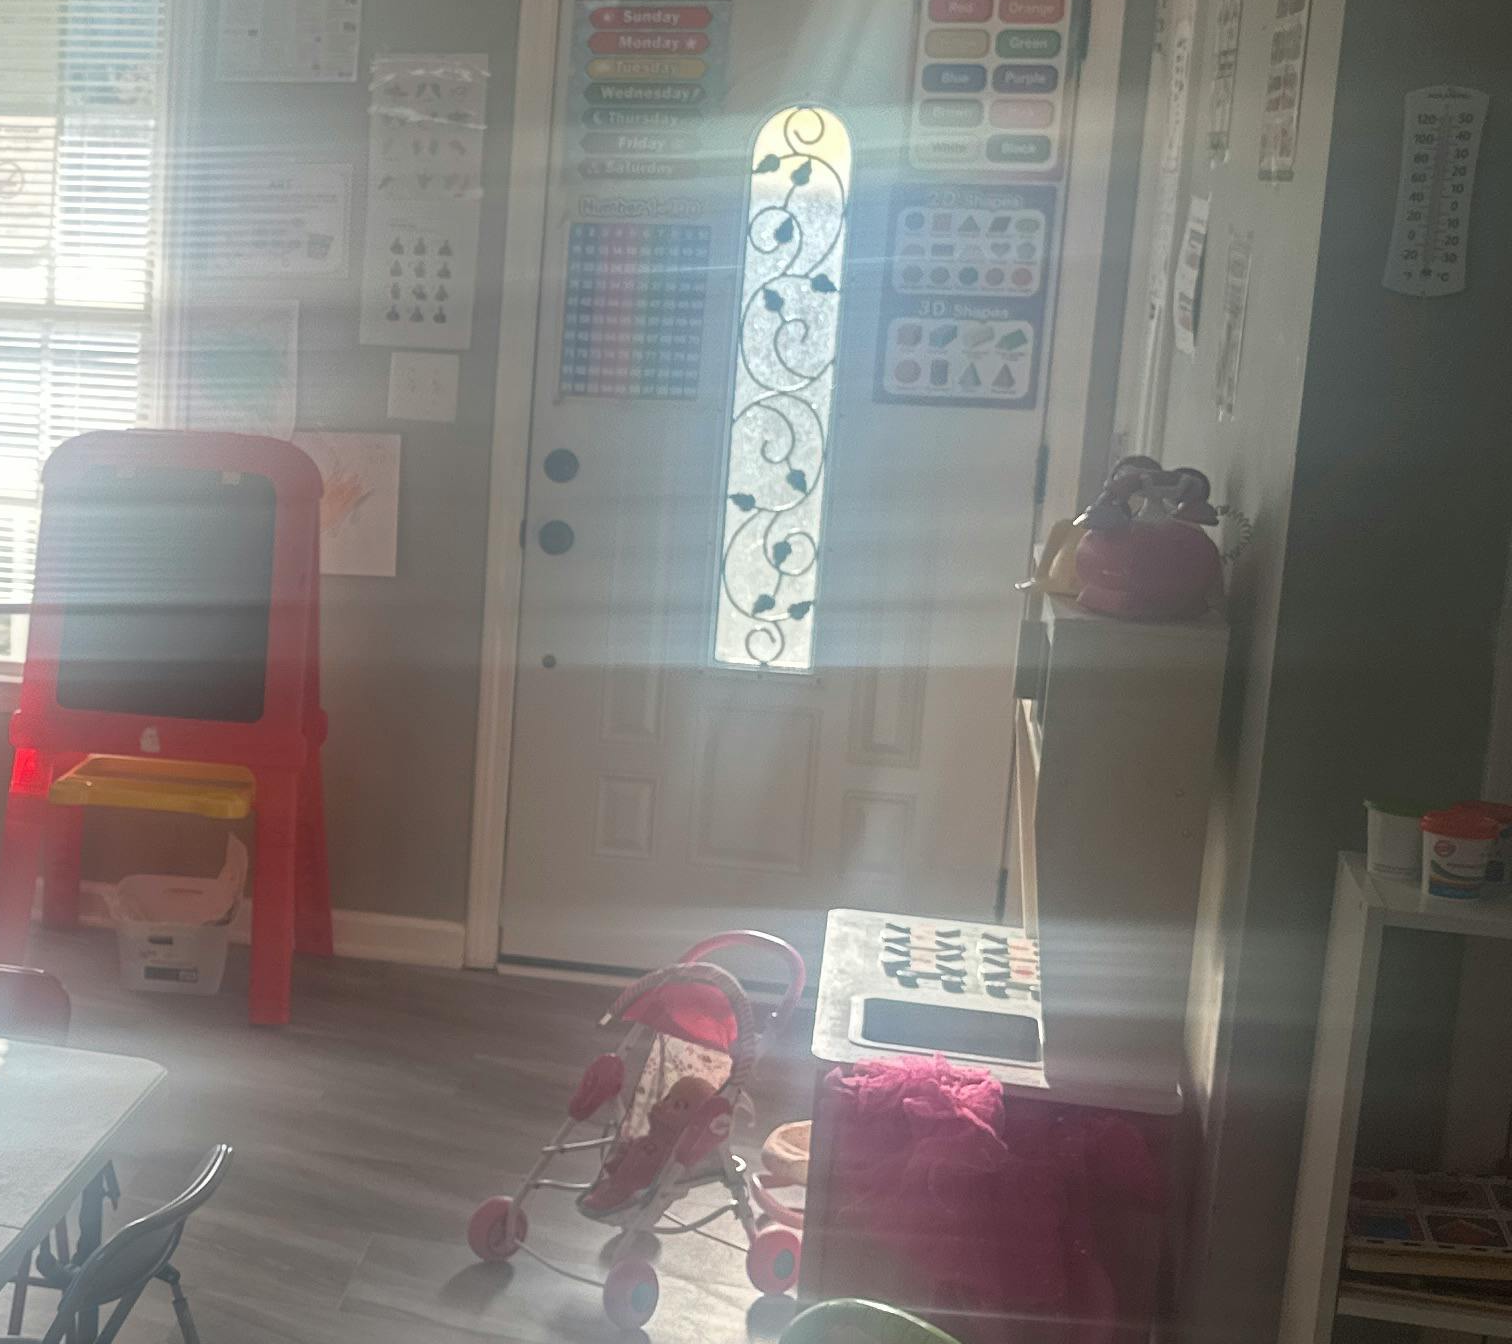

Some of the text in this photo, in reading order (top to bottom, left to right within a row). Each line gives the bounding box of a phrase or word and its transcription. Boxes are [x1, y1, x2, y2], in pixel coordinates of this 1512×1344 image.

[1008, 1, 1055, 17] Orange
[623, 10, 680, 25] Sunday
[618, 35, 680, 51] Monday
[1009, 36, 1048, 49] Green
[615, 61, 678, 76] Tuesday
[941, 72, 969, 84] Blue
[1005, 71, 1046, 86] Purple
[601, 86, 690, 101] Wednesday
[609, 112, 679, 128] Thursday
[1418, 114, 1436, 125] 120
[1459, 114, 1473, 124] 50
[618, 136, 665, 151] Friday
[1414, 134, 1433, 145] 100
[1456, 131, 1471, 141] 40
[606, 160, 672, 175] Saturday
[1451, 184, 1464, 194] 10
[967, 193, 1023, 210] Shapes
[1408, 192, 1424, 203] 40
[1450, 201, 1458, 211] 0
[1407, 230, 1416, 240] 0
[919, 300, 1009, 320] 3D Shapes
